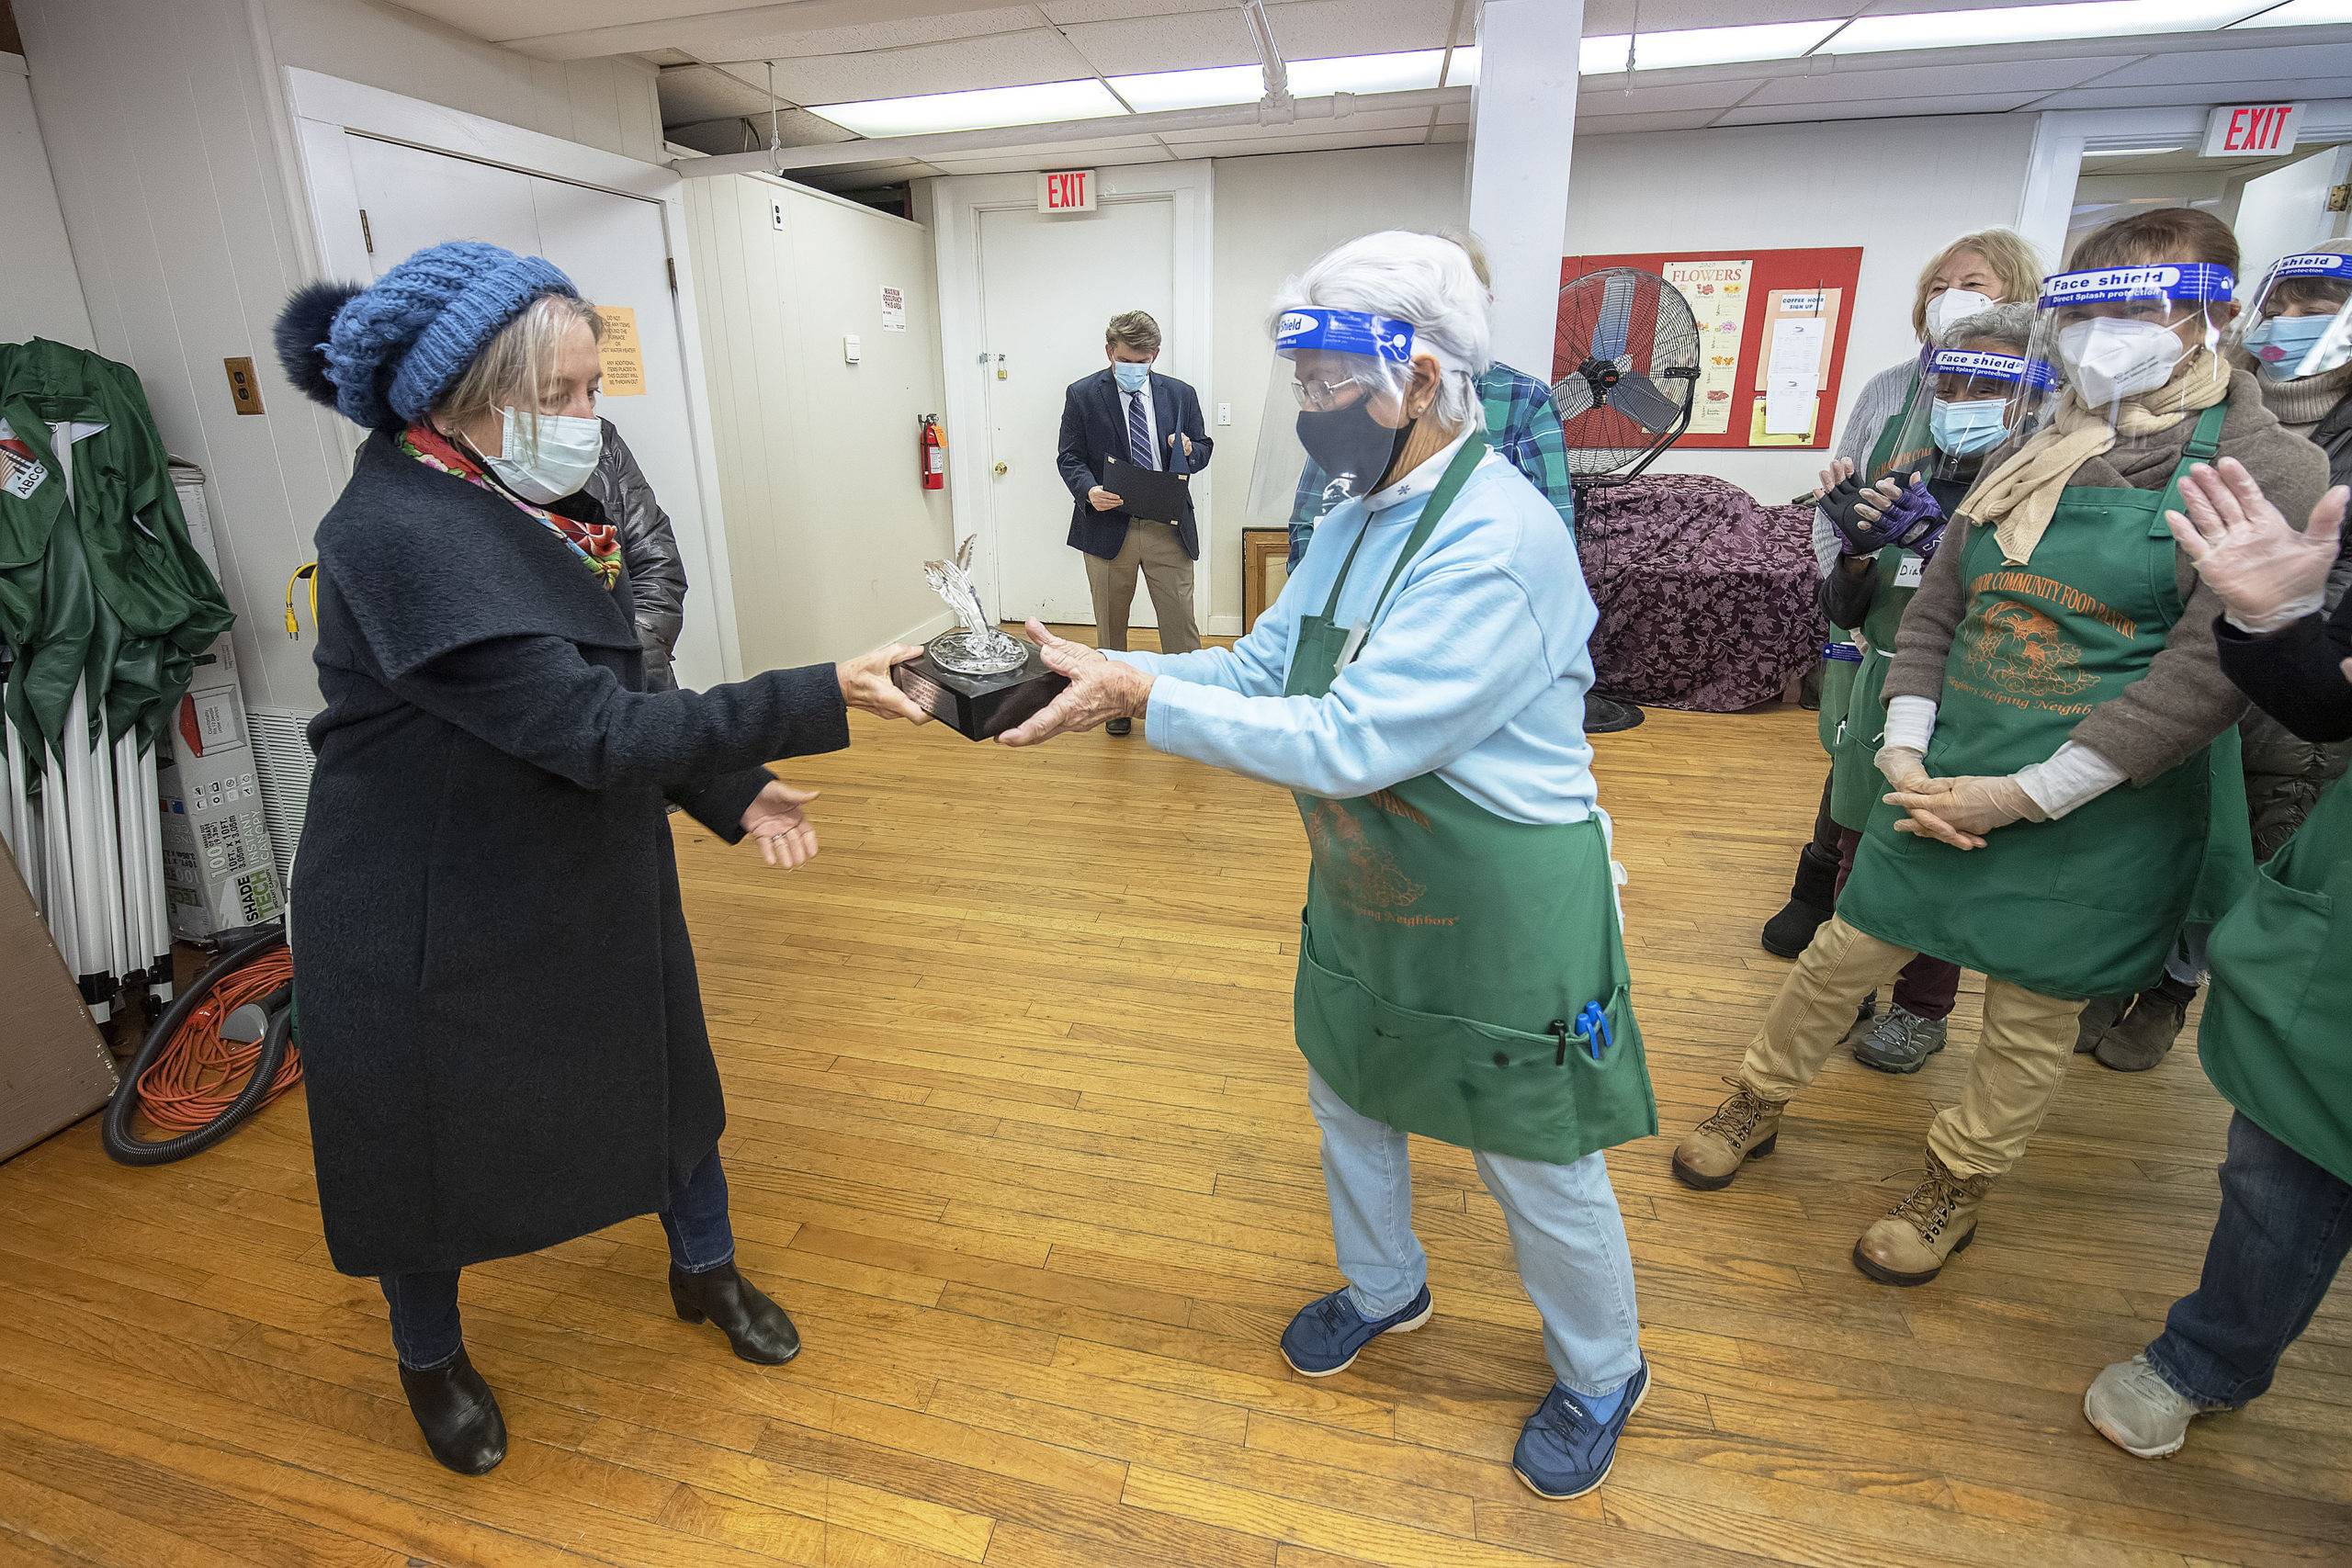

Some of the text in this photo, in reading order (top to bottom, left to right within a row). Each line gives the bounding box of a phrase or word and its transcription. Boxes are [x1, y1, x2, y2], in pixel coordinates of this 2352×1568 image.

[2223, 107, 2293, 151] EXIT
[1048, 173, 1086, 209] EXIT
[2282, 257, 2329, 268] shield
[1672, 268, 1742, 282] FLOWERS
[2053, 277, 2090, 292] Face
[2098, 271, 2164, 286] shield
[2052, 288, 2160, 304] Direct Splash protection
[1940, 354, 1968, 364] Face
[1973, 356, 2016, 369] shield
[1976, 369, 2010, 378] protection
[17, 466, 45, 494] ABCC
[1992, 571, 2063, 603] COMMUNITY
[2061, 584, 2096, 616] FOOD
[2095, 603, 2137, 640] PANTRY
[1980, 689, 2030, 710] Helping
[220, 817, 231, 840] 10FT.
[229, 815, 240, 838] 3.05m
[252, 810, 269, 861] CANOPY
[239, 813, 259, 865] INSTANT
[207, 845, 229, 879] 100
[228, 852, 238, 873] 10FT.
[237, 846, 246, 868] 3.05m
[237, 874, 259, 921] SHADE
[251, 869, 274, 919] TECH
